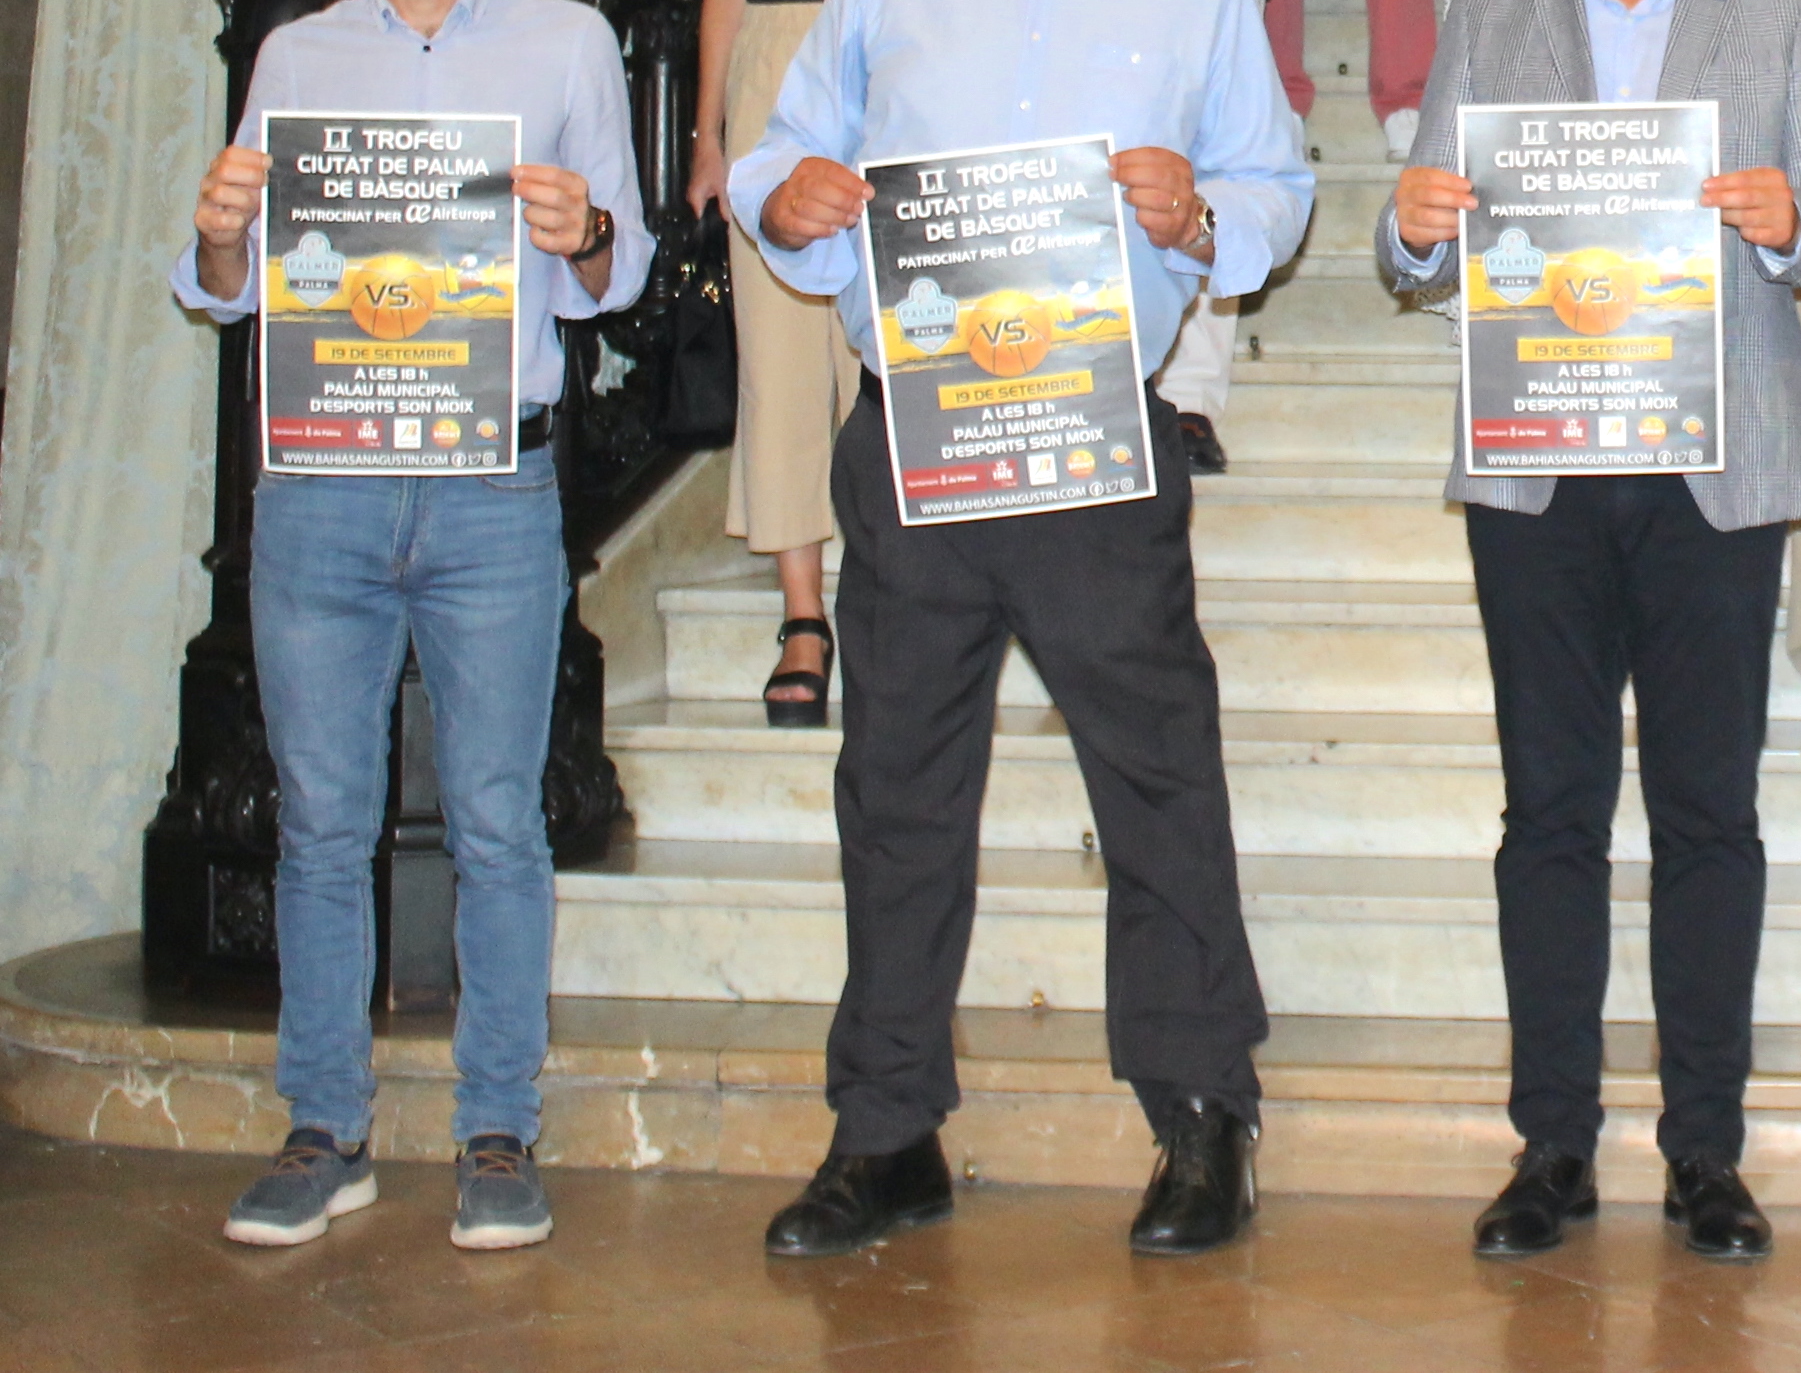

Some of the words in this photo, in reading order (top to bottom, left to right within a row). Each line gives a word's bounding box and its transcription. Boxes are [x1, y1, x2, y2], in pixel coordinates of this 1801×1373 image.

[361, 128, 463, 152] TROFEU
[1558, 118, 1659, 142] TROFEU
[296, 154, 373, 175] CIUTAT
[378, 156, 409, 175] DE
[413, 156, 489, 177] PALMA
[1494, 148, 1570, 169] CIUTAT
[1575, 148, 1605, 167] DE
[1610, 146, 1687, 166] PALMA
[955, 155, 1058, 189] TROFEU
[1521, 173, 1551, 192] DE
[1556, 168, 1661, 192] BÀSQUET
[322, 179, 353, 199] DE
[358, 176, 463, 200] BÀSQUET
[894, 194, 972, 222] CIUTAT
[975, 189, 1007, 212] DE
[1010, 180, 1088, 207] PALMA
[1489, 203, 1571, 218] PATROCINAT
[1573, 202, 1601, 215] PER
[290, 207, 372, 223] PATROCINAT
[374, 209, 402, 223] PER
[923, 220, 956, 243] DE
[959, 204, 1065, 238] BÀSQUET
[896, 247, 978, 271] PATROCINAT
[979, 244, 1007, 260] PER
[330, 347, 345, 358] 19
[350, 348, 369, 359] DE
[374, 348, 456, 361] SETEMBRE
[1534, 345, 1548, 357] 19
[1553, 345, 1572, 356] DE
[1577, 343, 1660, 357] SETEMBRE
[354, 366, 366, 380] A
[369, 367, 397, 381] LES
[400, 367, 416, 380] 18
[419, 367, 429, 381] h
[1558, 364, 1569, 378] A
[1572, 363, 1601, 377] LES
[1603, 363, 1620, 377] 18
[1622, 363, 1632, 376] h
[323, 381, 373, 397] PALAU
[377, 382, 460, 398] MUNICIPAL
[954, 390, 970, 403] 19
[974, 388, 994, 401] DE
[997, 376, 1080, 399] SETEMBRE
[1527, 380, 1576, 395] PALAU
[1581, 379, 1663, 395] MUNICIPAL
[309, 399, 394, 414] D'ESPORTS
[398, 400, 431, 414] SON
[435, 400, 474, 414] MOIX
[980, 407, 993, 422] A
[995, 403, 1025, 420] LES
[1026, 401, 1043, 416] 18
[1045, 399, 1056, 414] h
[1513, 398, 1599, 413] D'ESPORTS
[1602, 397, 1636, 411] SON
[1639, 396, 1678, 410] MOIX
[952, 422, 1003, 442] PALAU
[1005, 412, 1088, 436] MUNICIPAL
[941, 437, 1026, 461] D'ESPORTS
[1028, 432, 1062, 450] SON
[1065, 427, 1105, 445] MOIX
[281, 450, 448, 466] WWW.BAHIASANAGUSTIN.COM
[1485, 451, 1654, 467] WWW.BAHIASANAGUSTIN.COM
[919, 483, 1086, 517] WWW.BAHIASANAGUSTIN.COM
